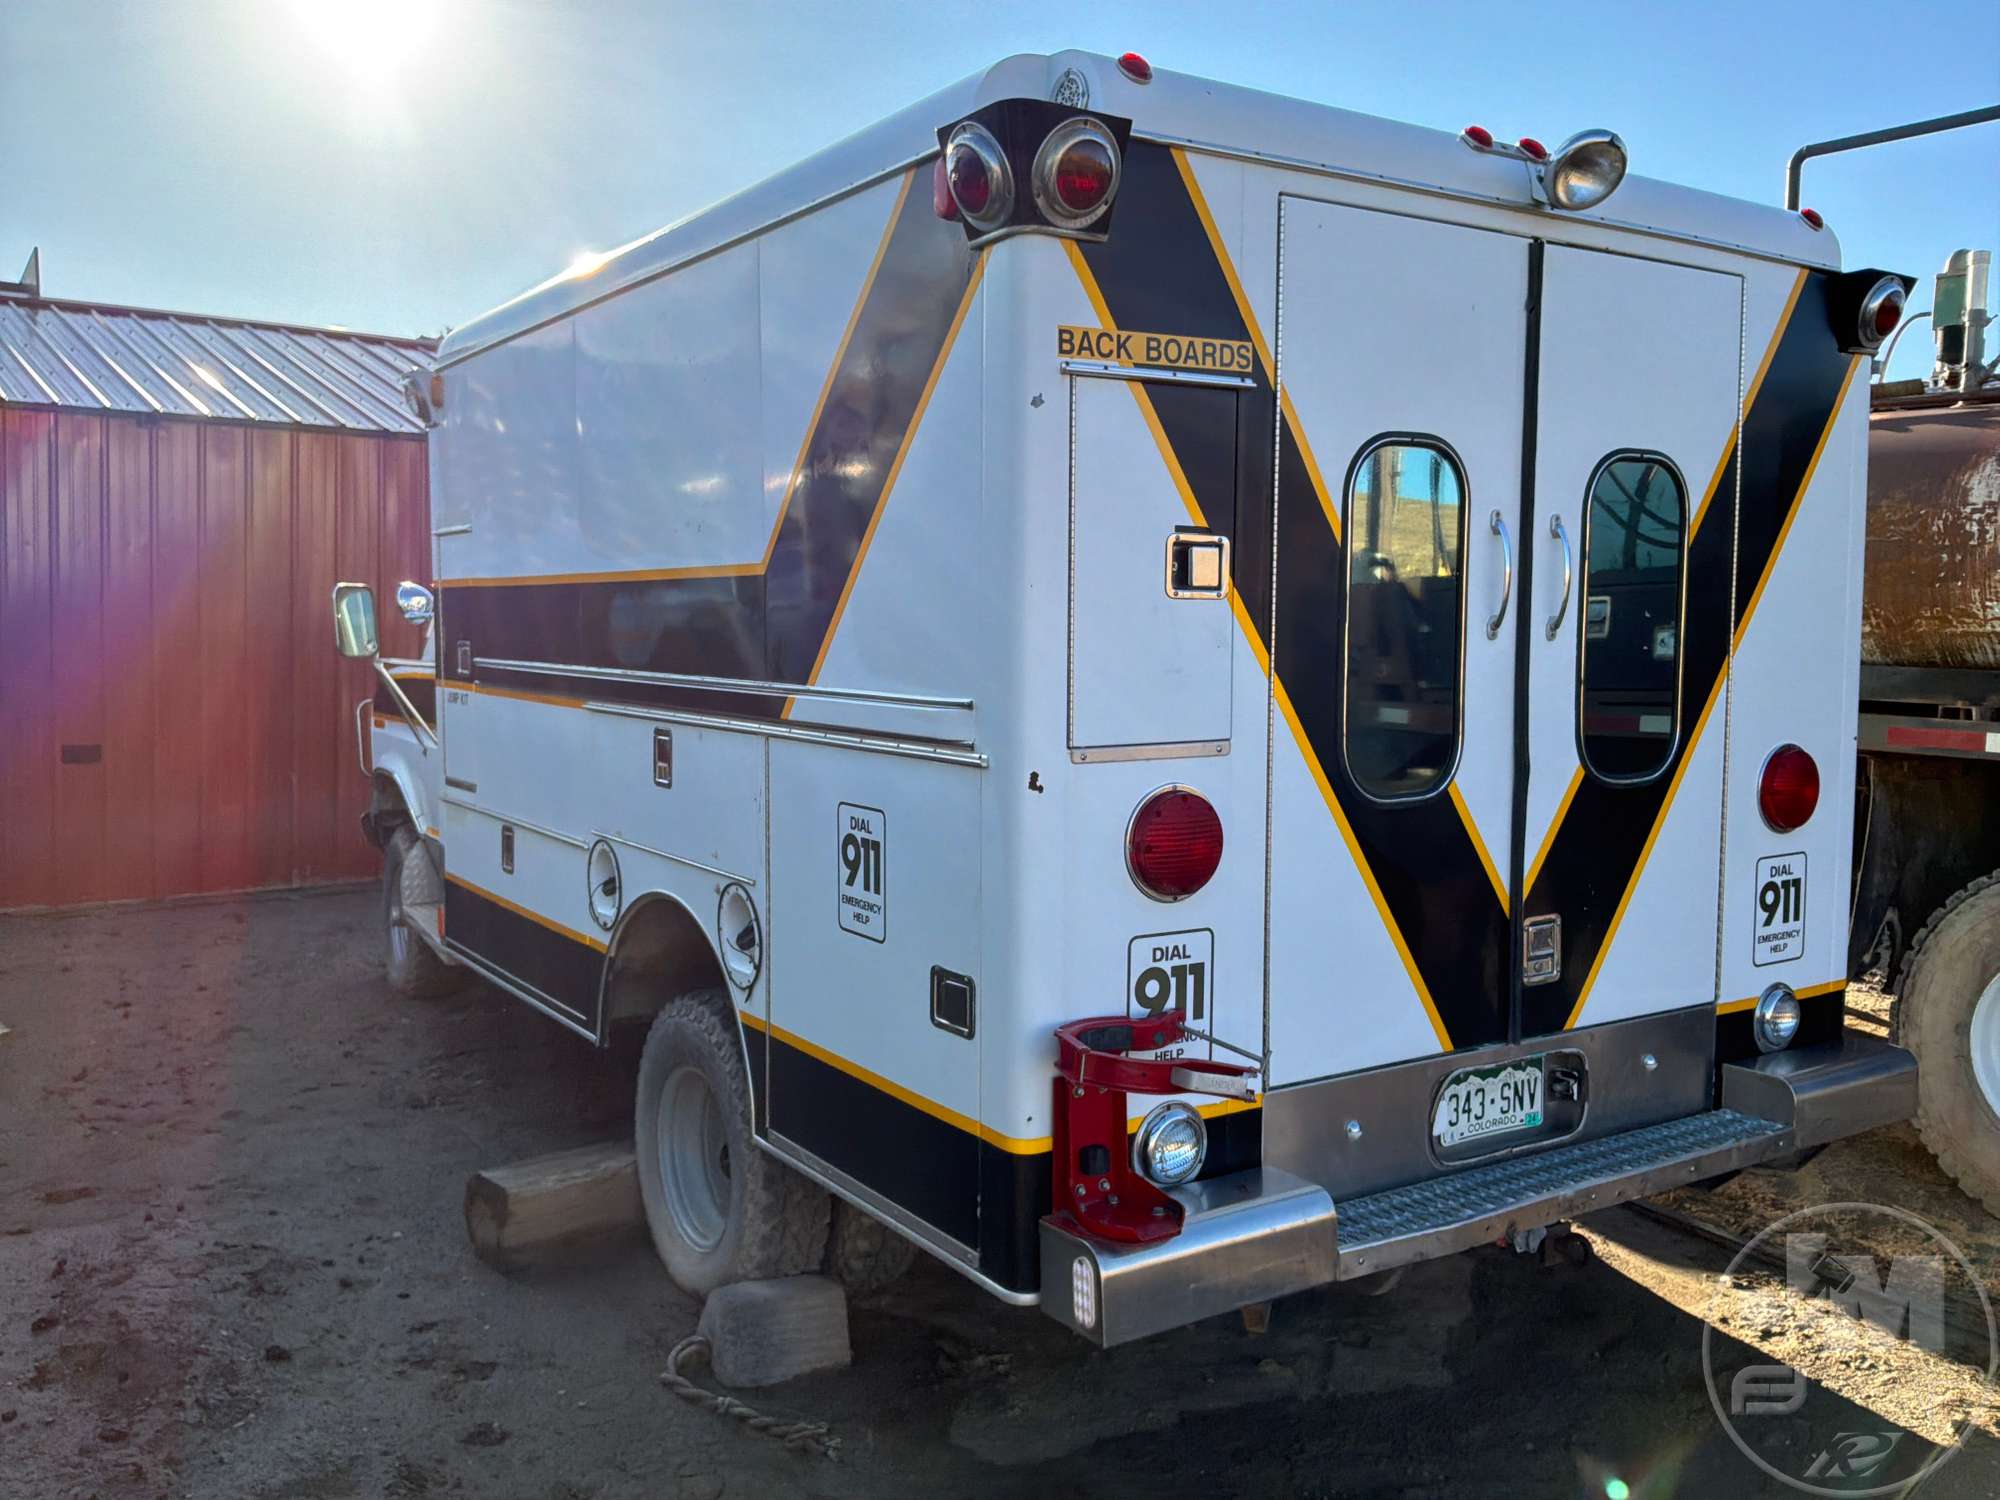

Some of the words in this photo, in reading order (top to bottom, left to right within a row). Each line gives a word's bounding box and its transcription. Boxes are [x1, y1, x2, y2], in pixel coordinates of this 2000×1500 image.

[1057, 329, 1133, 360] BACK
[1145, 336, 1251, 370] BOARDS
[850, 816, 872, 834] DIAL
[841, 833, 881, 895] 911
[1770, 864, 1793, 878] DIAL
[841, 894, 881, 915] EMERGENCY
[1759, 877, 1801, 927] 911
[853, 911, 870, 925] HELP
[1758, 929, 1800, 944] EMERGENCY
[1152, 944, 1191, 963] DIAL
[1770, 943, 1788, 953] HELP
[1135, 962, 1205, 1020] 911
[1154, 1048, 1184, 1061] HELP
[1467, 1114, 1517, 1134] COLORADO
